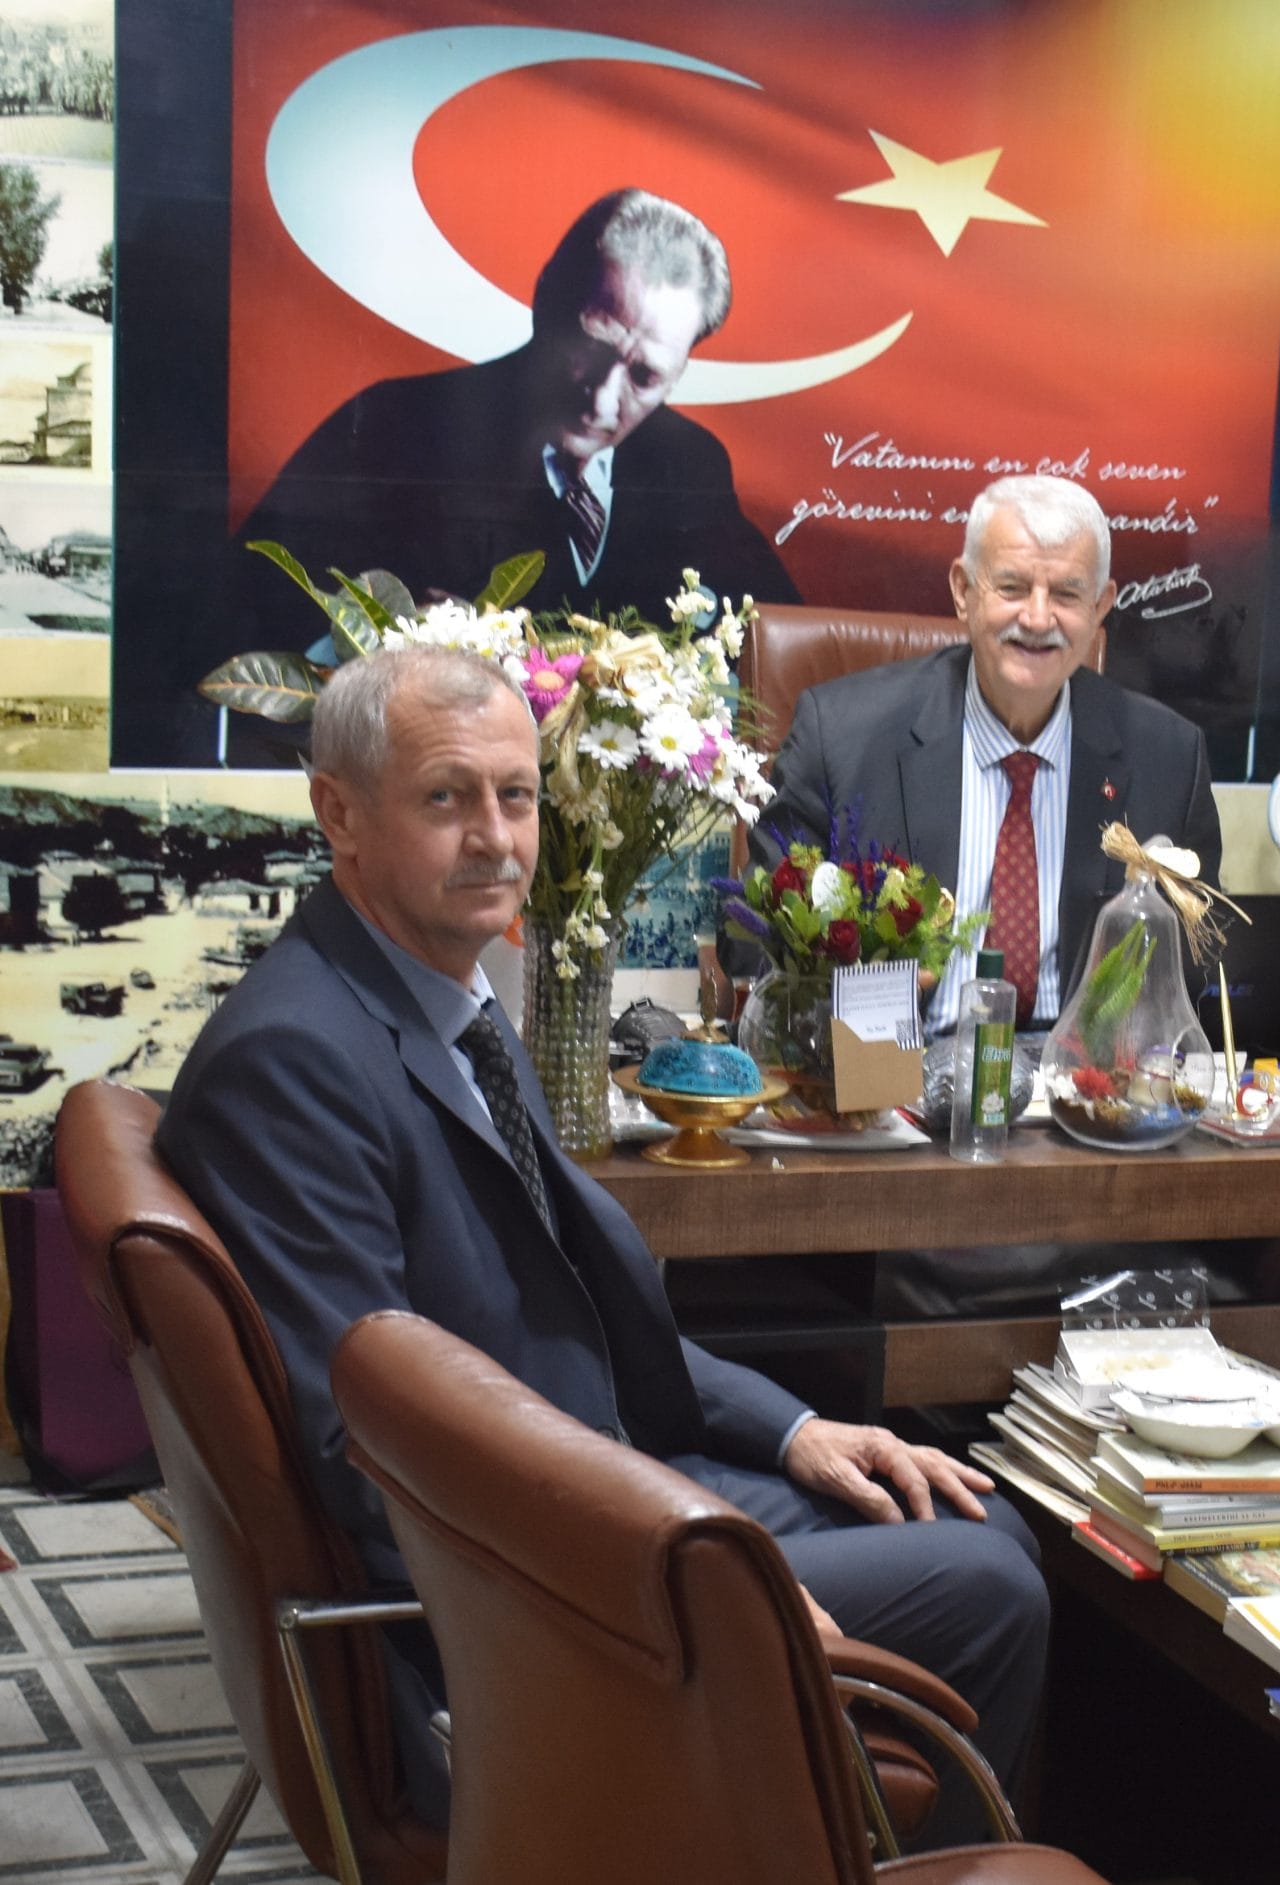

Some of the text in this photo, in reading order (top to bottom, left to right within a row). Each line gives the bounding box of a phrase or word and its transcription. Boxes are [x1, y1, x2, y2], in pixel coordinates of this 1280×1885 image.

[983, 456, 1029, 474] en
[1099, 461, 1187, 481] seven
[774, 487, 932, 546] görevini
